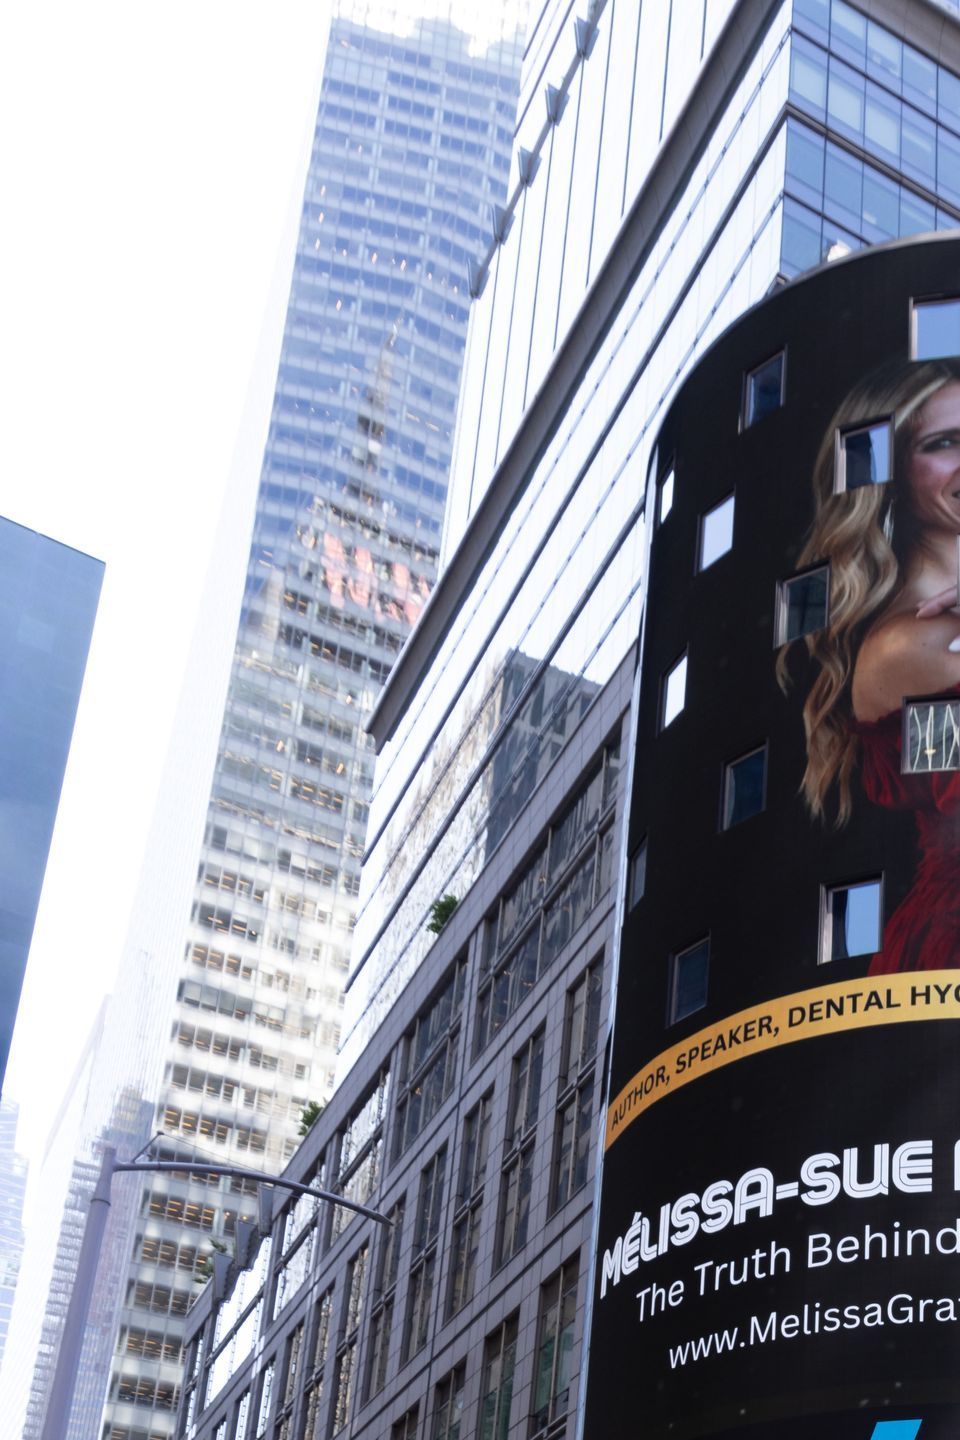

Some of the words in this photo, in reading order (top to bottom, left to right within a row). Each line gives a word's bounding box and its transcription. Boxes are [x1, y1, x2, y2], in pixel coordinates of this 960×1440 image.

[611, 1064, 671, 1131] AUTHOR,
[675, 1015, 781, 1076] SPEAKER,
[787, 988, 902, 1029] DENTAL
[600, 1139, 934, 1300] MÉLISSA-SUE
[636, 1280, 685, 1322] The
[694, 1241, 792, 1296] Truth
